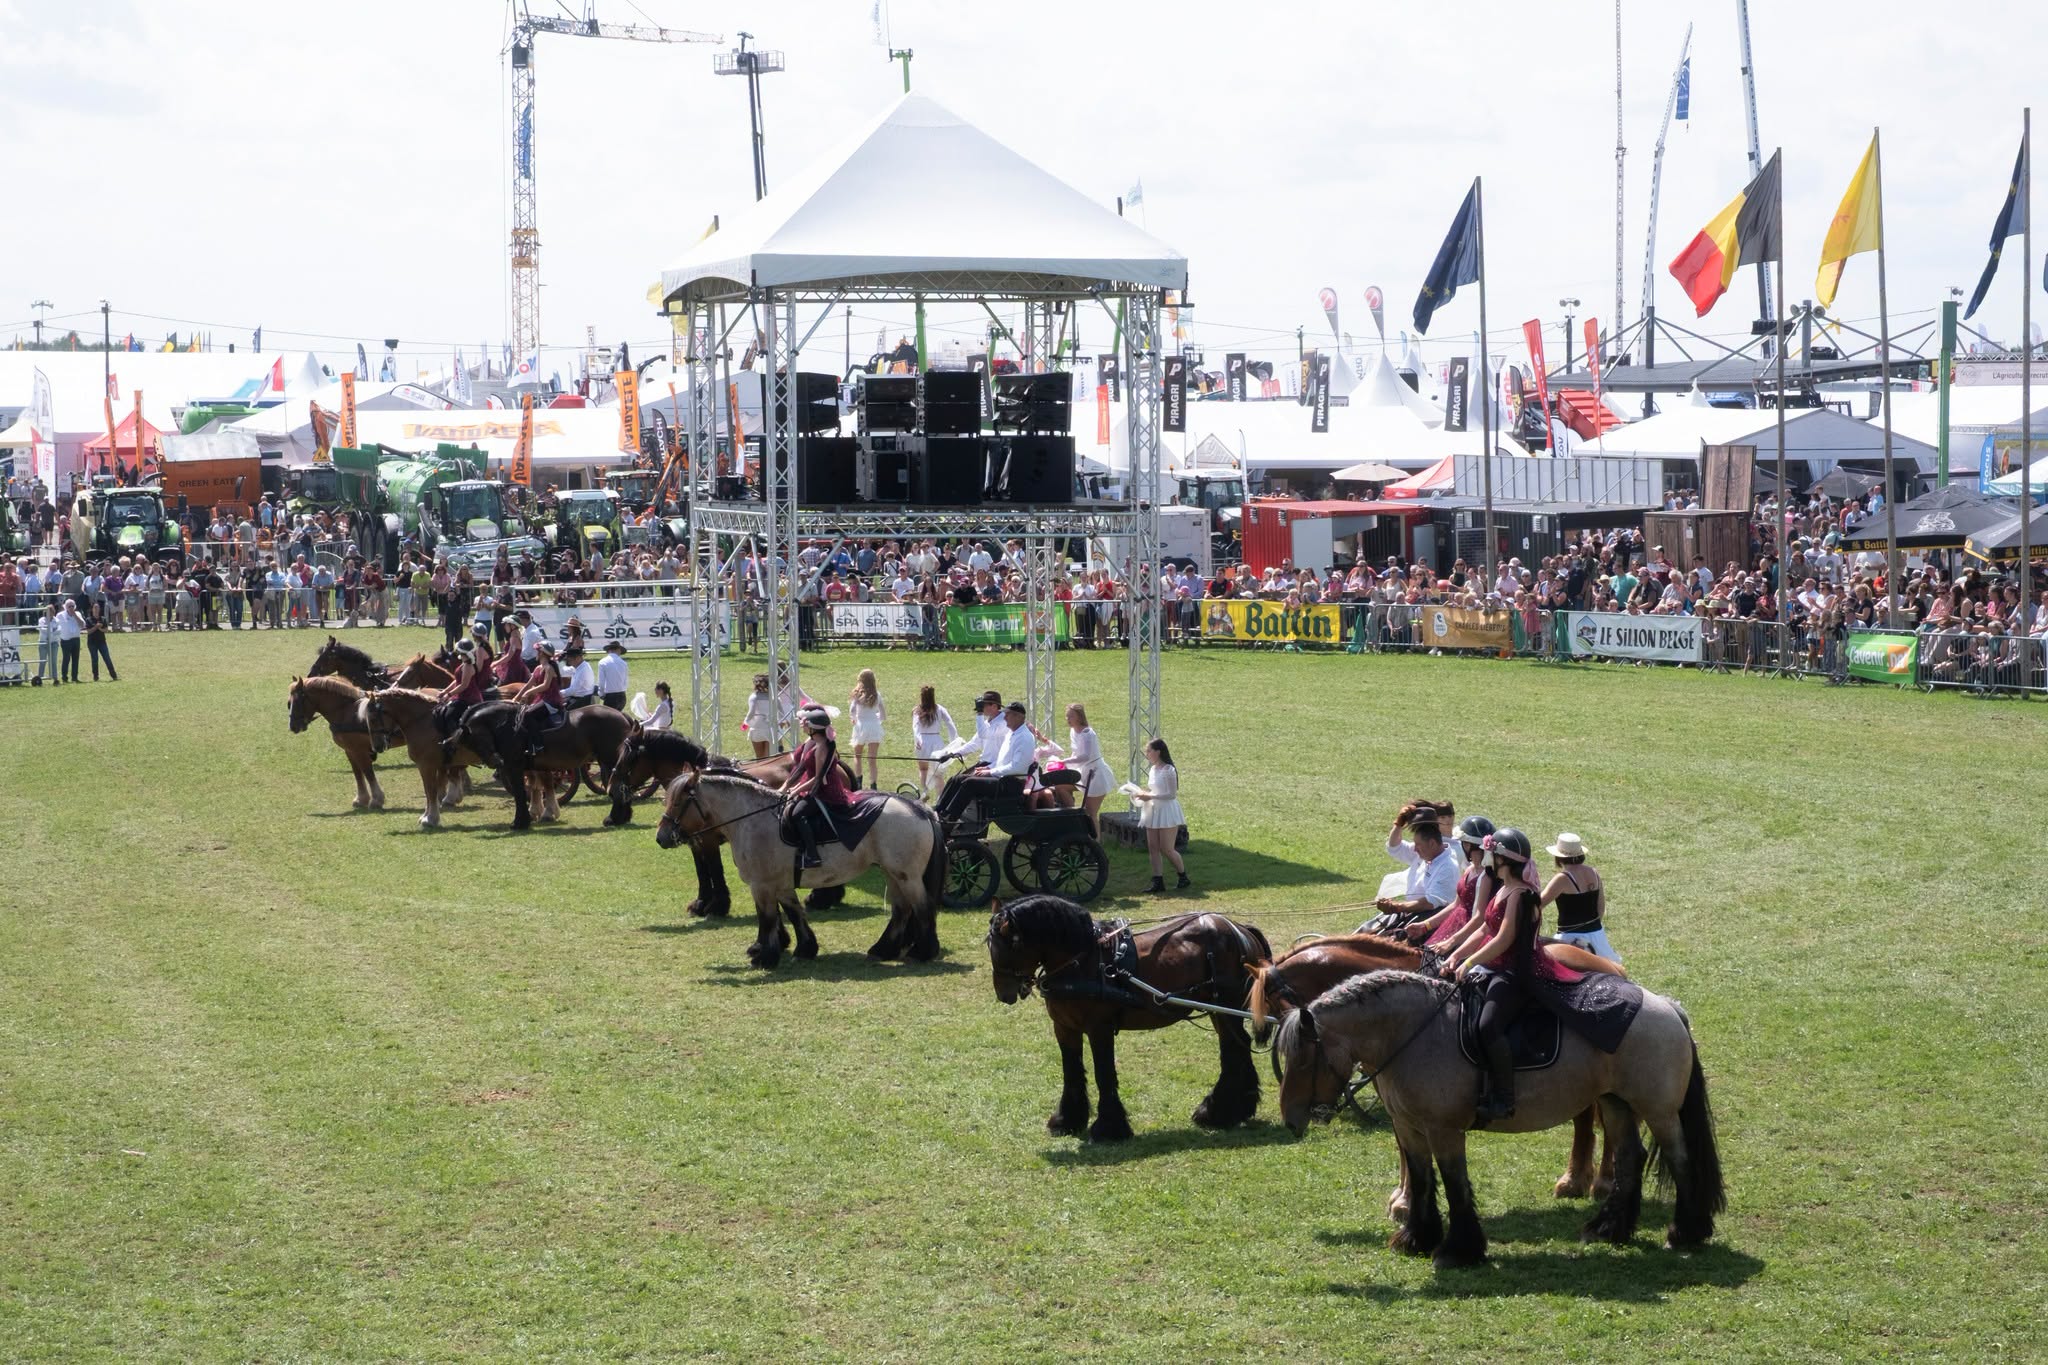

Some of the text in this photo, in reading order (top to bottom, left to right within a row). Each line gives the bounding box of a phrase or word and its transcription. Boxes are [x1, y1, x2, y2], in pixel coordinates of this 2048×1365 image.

[1993, 372, 2024, 380] L'Agricultu
[1170, 384, 1180, 426] PIRAGRI
[1316, 385, 1326, 426] PIRAGRI
[1452, 385, 1462, 426] PIRAGRI
[178, 477, 238, 488] GREEN EATE
[836, 618, 920, 629] SPA SPA SPA
[1245, 601, 1333, 638] Battin
[559, 628, 593, 640] SA
[604, 627, 638, 640] SPA
[649, 625, 683, 638] SPA
[1601, 626, 1612, 646] LE
[1659, 630, 1695, 650] BELGE
[0, 651, 20, 663] PA
